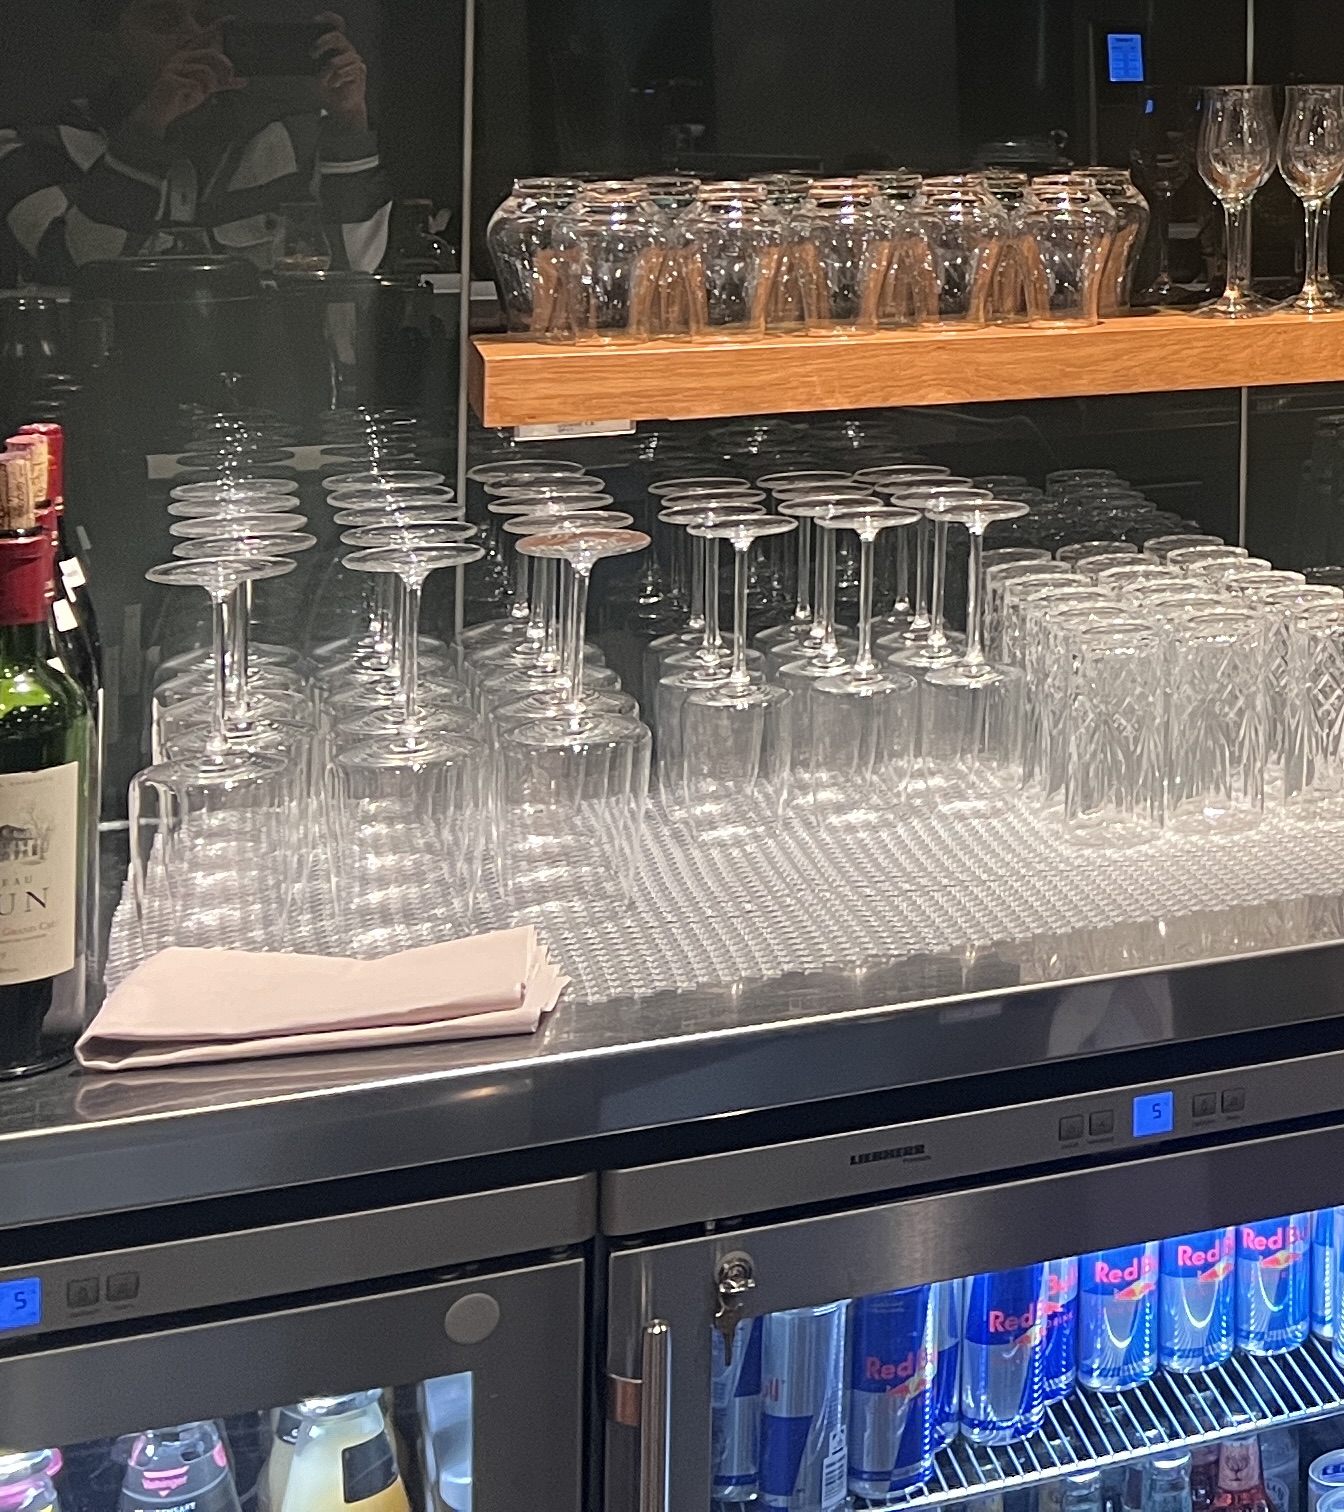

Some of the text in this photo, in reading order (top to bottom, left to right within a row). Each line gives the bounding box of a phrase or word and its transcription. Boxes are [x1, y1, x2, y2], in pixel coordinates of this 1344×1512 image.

[1152, 1102, 1162, 1120] 5
[849, 1143, 926, 1166] LIEBHERR
[1242, 1225, 1284, 1251] Red
[1177, 1238, 1221, 1267] Red
[1095, 1257, 1139, 1284] Red
[14, 1291, 27, 1311] 5
[989, 1306, 1035, 1334] Red
[866, 1353, 915, 1381] Red
